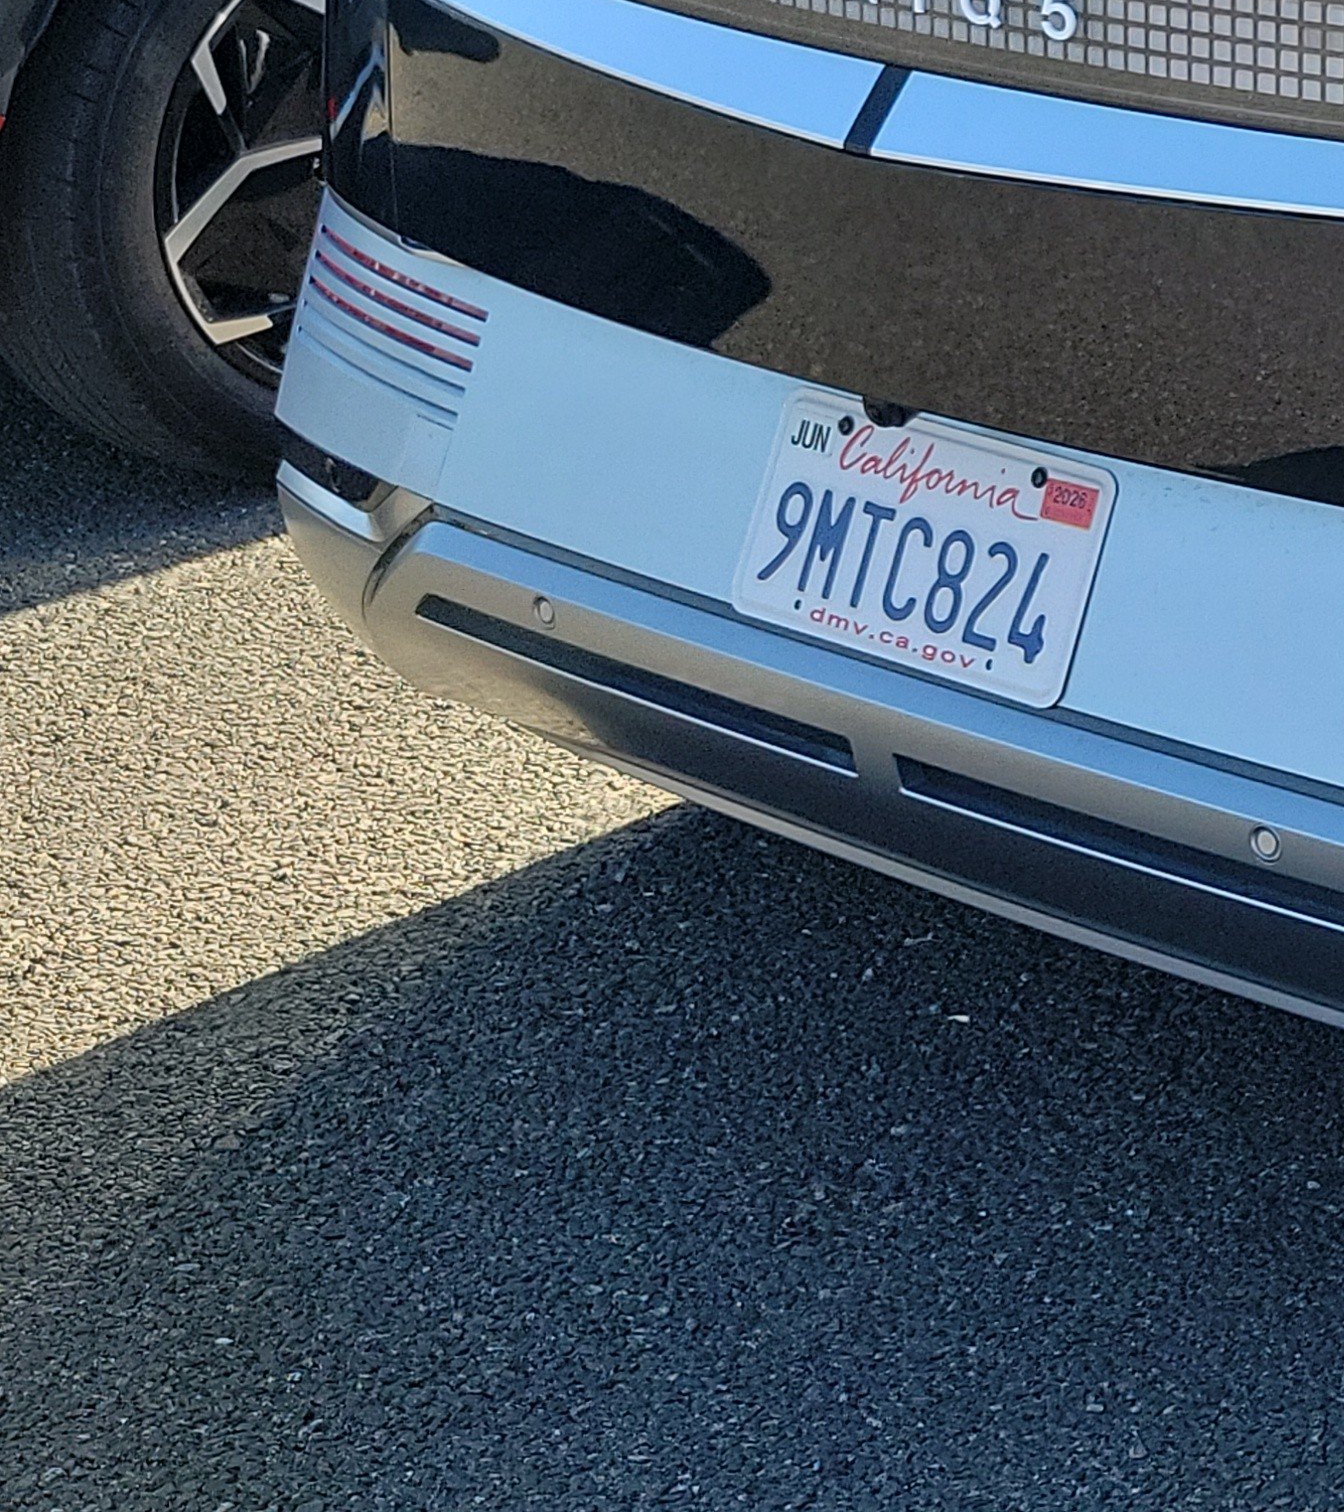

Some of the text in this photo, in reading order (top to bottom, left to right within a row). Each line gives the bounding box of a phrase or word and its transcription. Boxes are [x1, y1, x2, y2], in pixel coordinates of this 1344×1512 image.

[791, 419, 831, 453] JUN
[839, 424, 1039, 521] California
[1053, 486, 1087, 509] 2026
[757, 481, 1050, 664] 9MTC824
[810, 607, 975, 669] dmv.ca.gov
